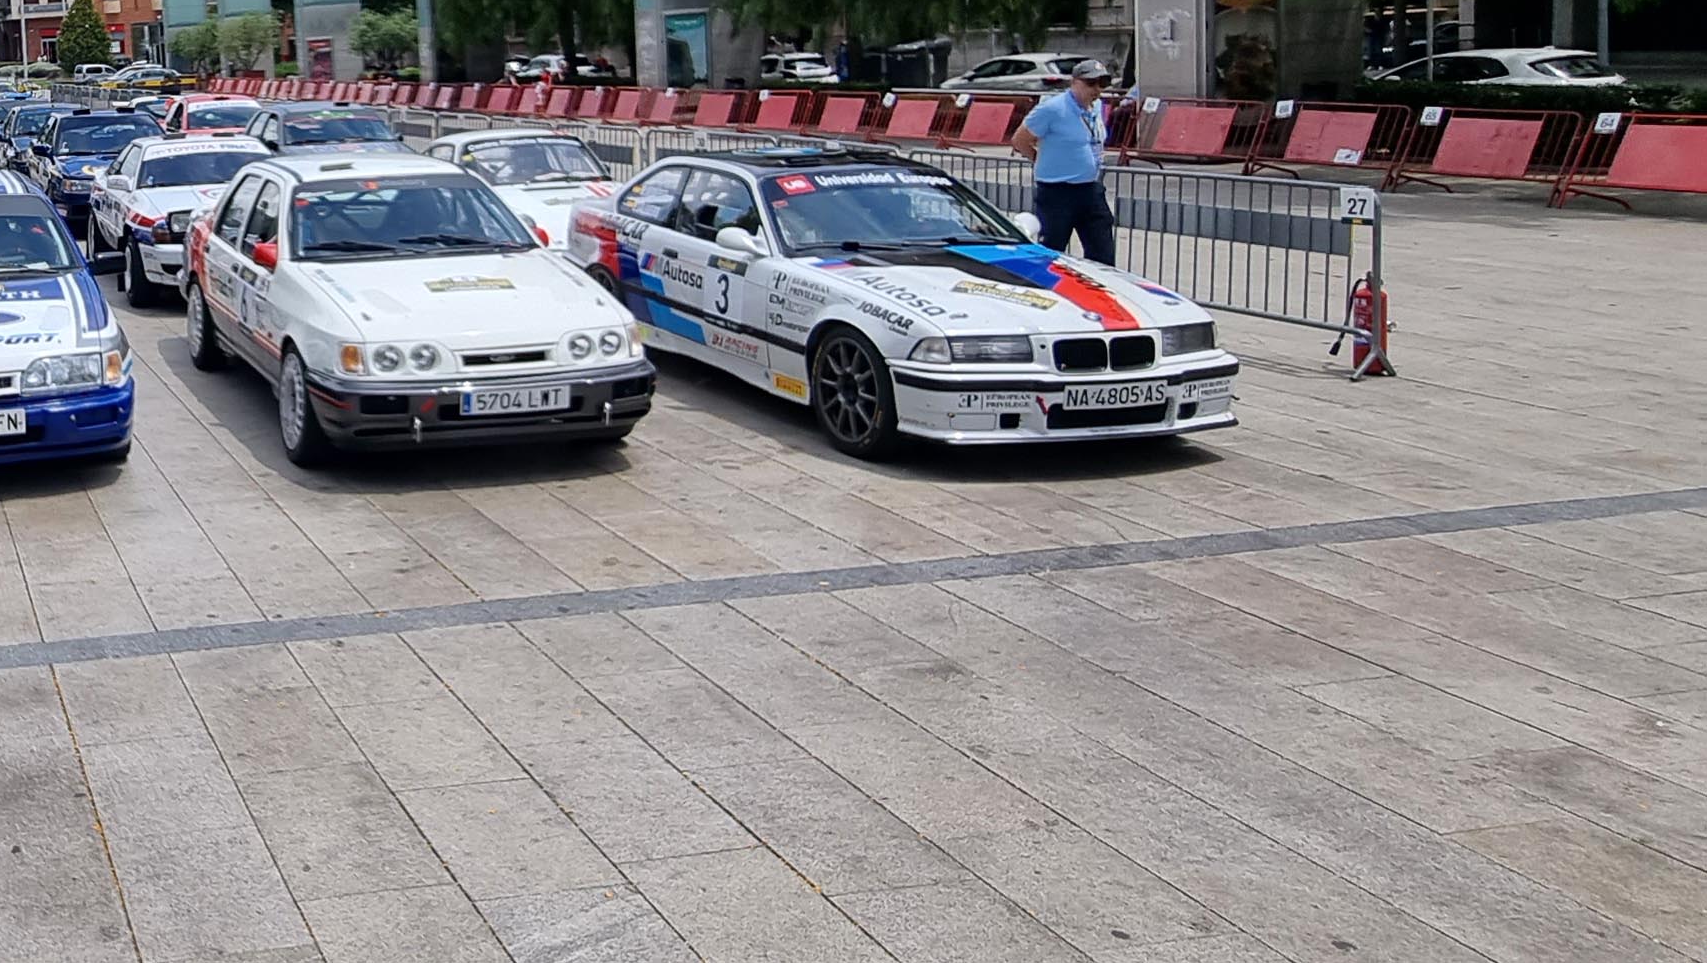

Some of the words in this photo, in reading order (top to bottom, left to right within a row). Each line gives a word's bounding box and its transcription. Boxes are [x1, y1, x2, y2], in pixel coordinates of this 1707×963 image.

[1600, 117, 1614, 129] 64
[165, 144, 215, 154] TOYOTA
[814, 172, 895, 187] Universidad
[1347, 198, 1368, 215] 27
[661, 259, 704, 291] Autosa
[714, 273, 730, 305] 3
[854, 275, 947, 317] Autosa
[856, 300, 915, 331] JOBACAR
[476, 391, 522, 411] 5704
[985, 400, 1031, 410] PRIVILEGE
